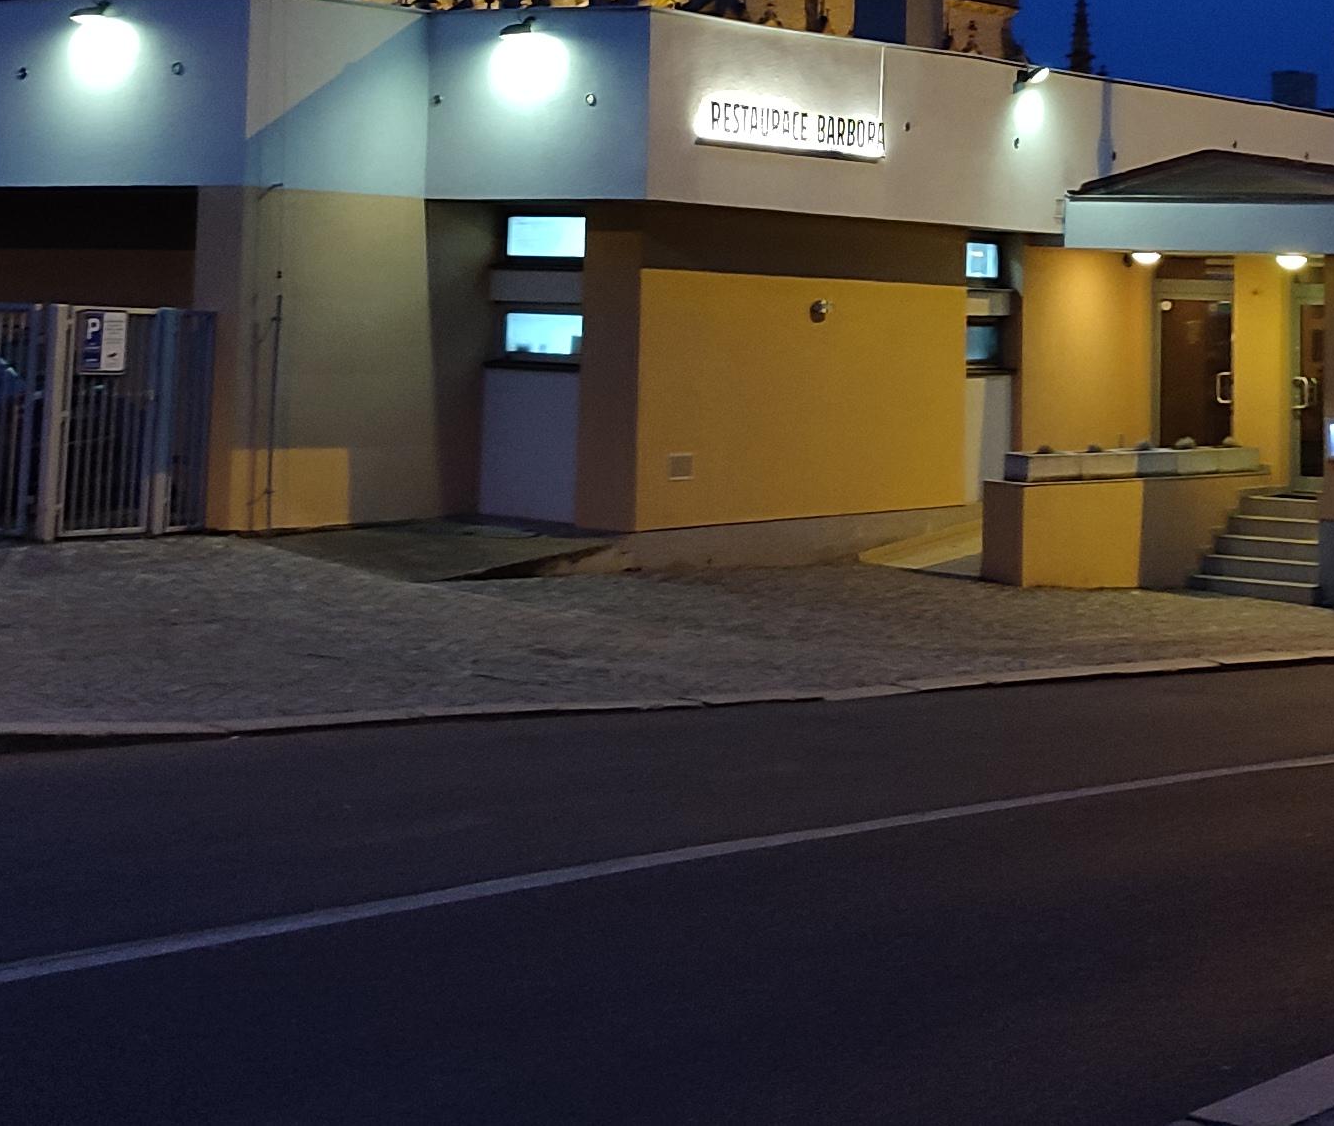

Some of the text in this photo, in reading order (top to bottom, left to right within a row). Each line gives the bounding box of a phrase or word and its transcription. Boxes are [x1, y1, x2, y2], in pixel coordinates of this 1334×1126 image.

[711, 101, 886, 151] RESTAURACE BARBORA
[87, 318, 100, 340] P
